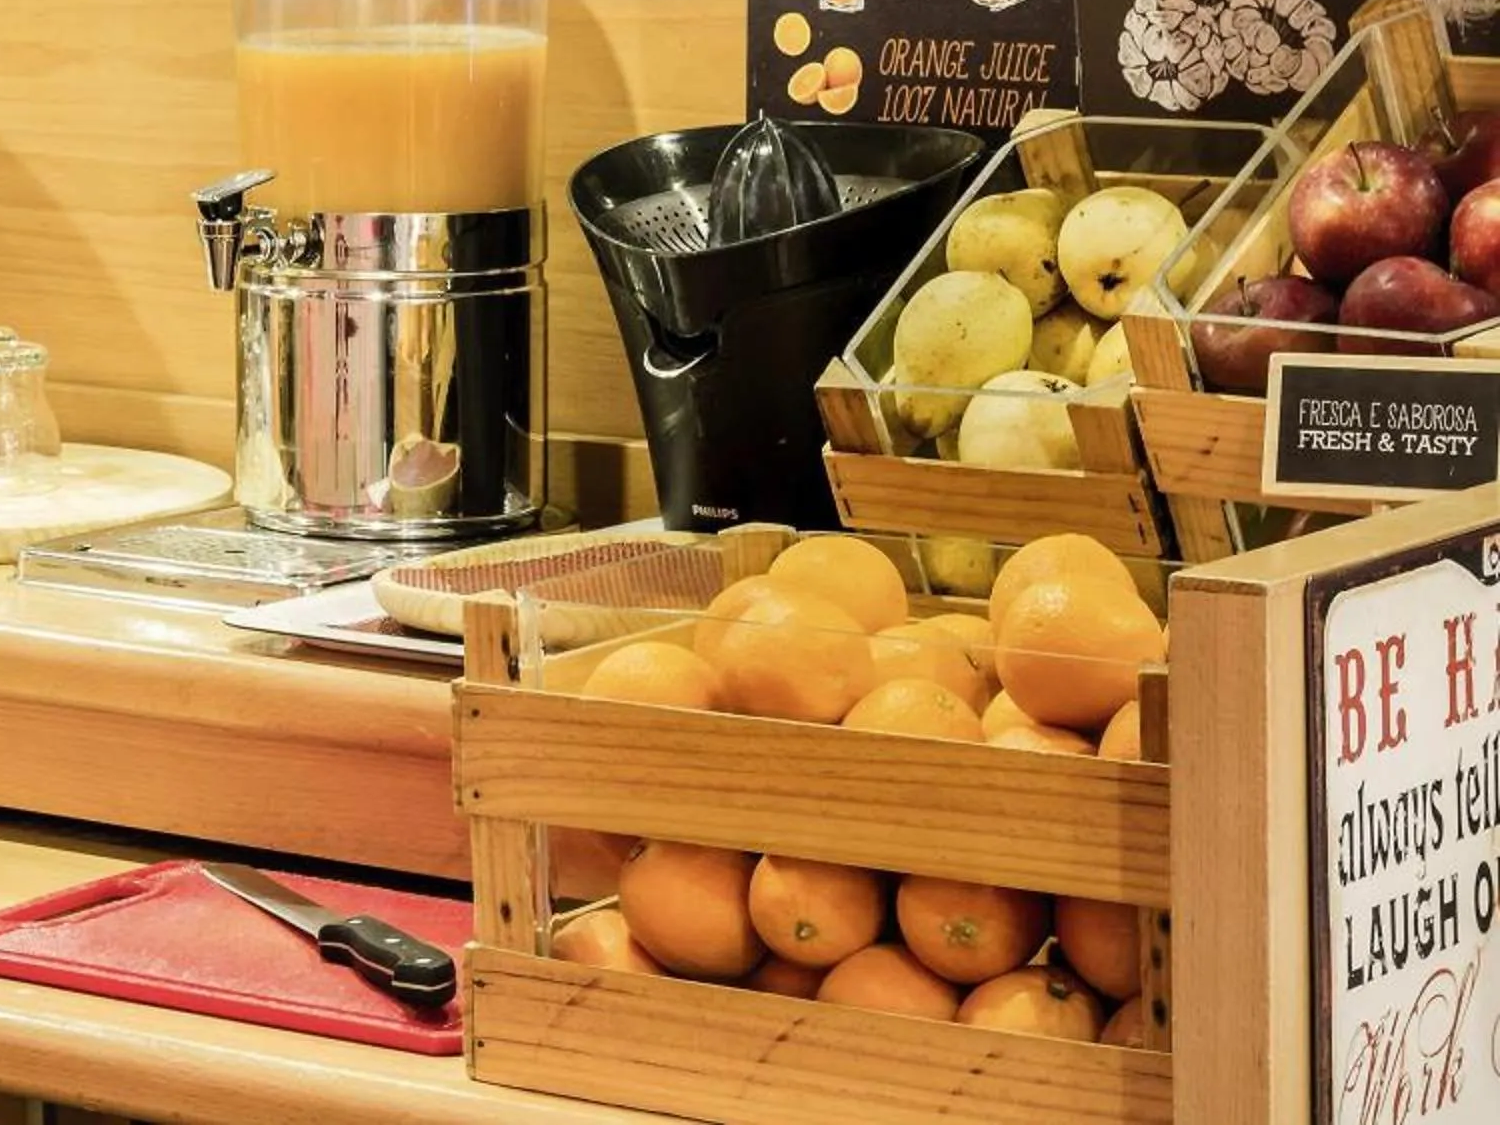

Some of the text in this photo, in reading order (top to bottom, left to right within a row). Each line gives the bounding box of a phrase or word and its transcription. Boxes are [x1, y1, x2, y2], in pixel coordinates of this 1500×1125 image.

[879, 38, 1056, 82] ORANGE JUICE
[1299, 398, 1477, 433] FRESCA E SABOROSA
[1298, 429, 1478, 456] FRESH & TASTY
[691, 504, 739, 520] PHILIPS
[1334, 631, 1408, 767] BE
[1337, 775, 1444, 889] always
[1344, 855, 1500, 991] LAUGH O
